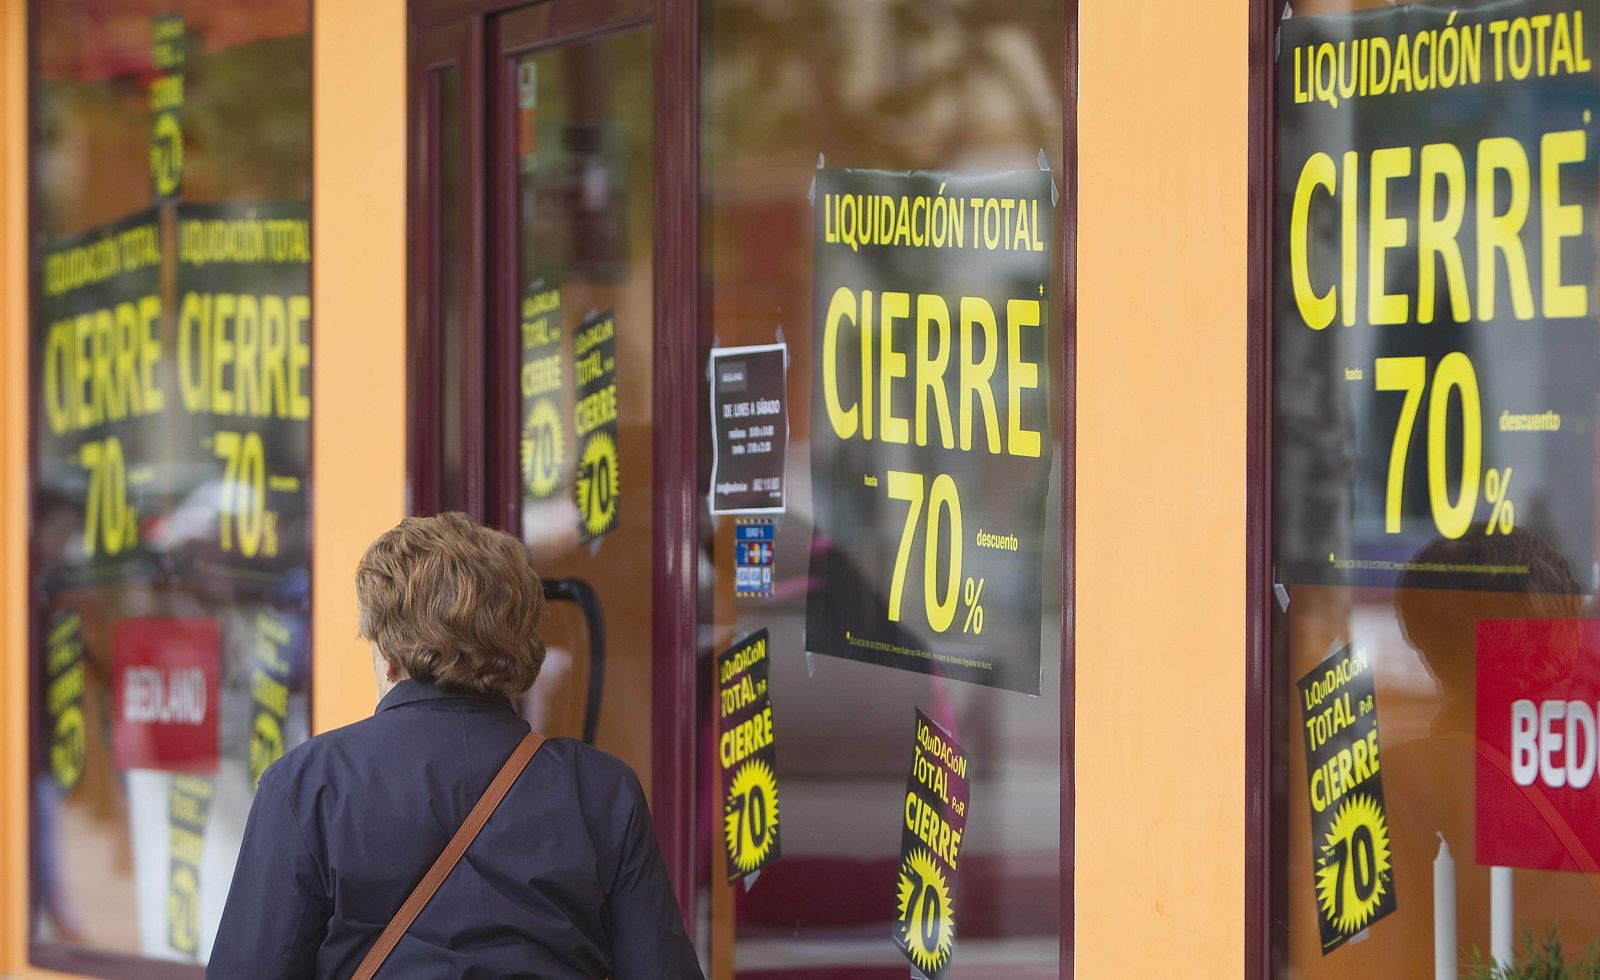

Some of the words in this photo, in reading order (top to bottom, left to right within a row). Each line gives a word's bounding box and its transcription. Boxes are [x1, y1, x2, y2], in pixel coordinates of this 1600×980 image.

[1294, 10, 1482, 109] LIQUIDACIÓN
[1489, 10, 1592, 81] TOTAL
[824, 182, 965, 252] LIQUIDACIÓN
[970, 197, 1044, 252] TOTAL
[1290, 130, 1588, 330] CIERRE
[44, 296, 163, 437] CIERRE
[177, 291, 310, 420] CIERRE
[823, 287, 1041, 457] CIERRE
[575, 383, 617, 436] CIERRE
[1375, 352, 1482, 539] 70
[1484, 467, 1515, 536] %
[1498, 410, 1561, 431] descuento
[887, 470, 963, 633] 70
[963, 577, 985, 635] %
[976, 529, 1018, 552] descuento
[720, 706, 774, 769] CIERRE
[721, 673, 756, 718] TOTAL
[1306, 692, 1356, 751] TOTAL
[913, 745, 949, 804] TOTAL
[1310, 728, 1380, 813] CIERRE
[1511, 699, 1600, 789] BED
[731, 785, 766, 856] 70
[905, 791, 962, 870] CIERRE
[902, 864, 941, 953] 70
[1327, 824, 1376, 917] 70
